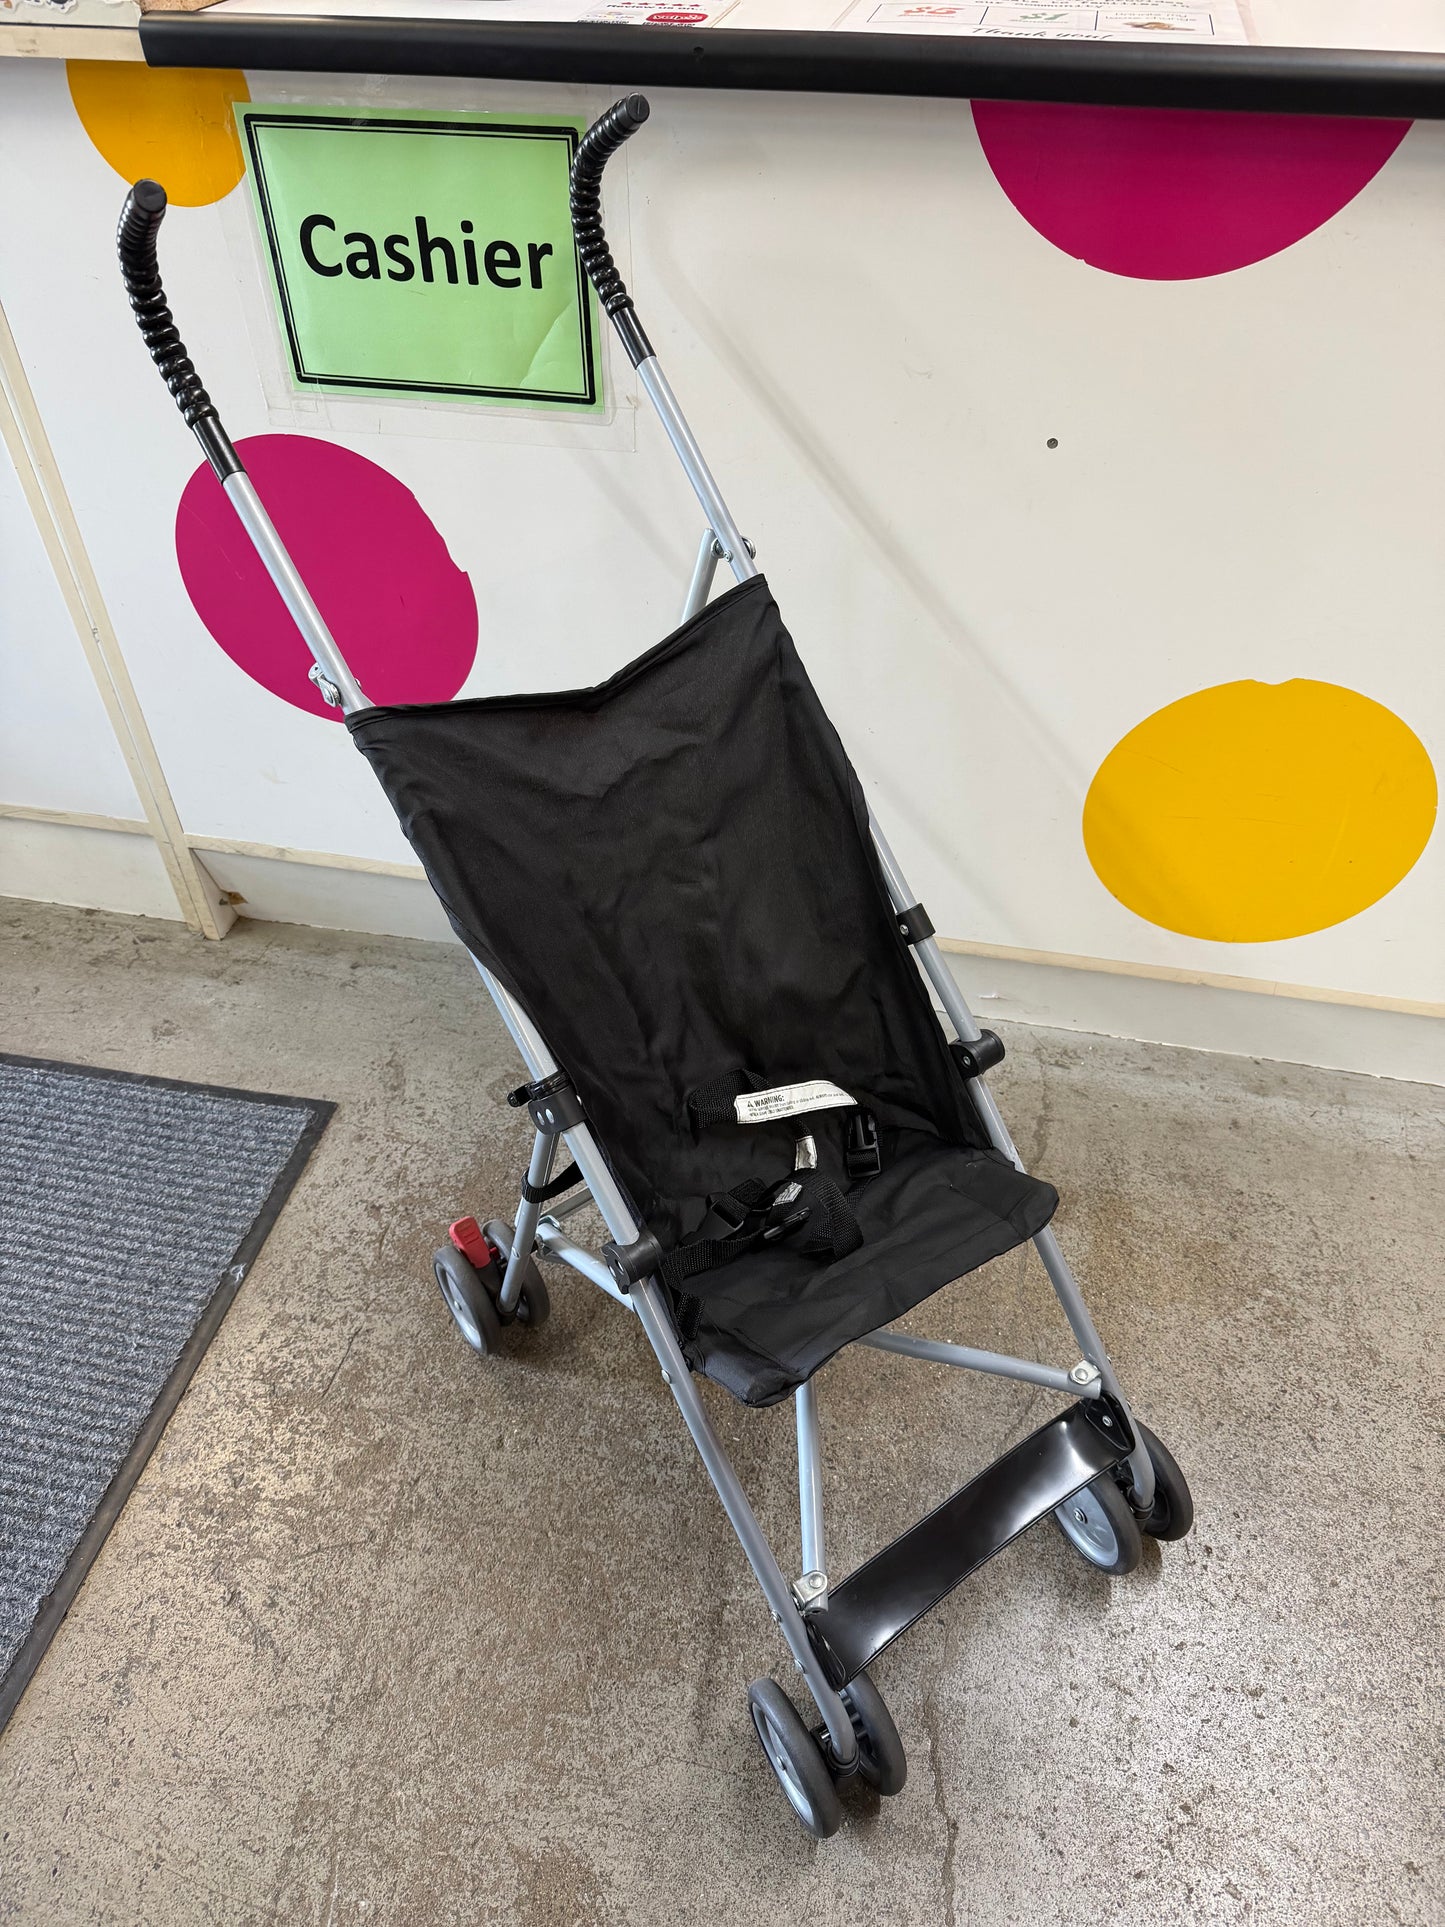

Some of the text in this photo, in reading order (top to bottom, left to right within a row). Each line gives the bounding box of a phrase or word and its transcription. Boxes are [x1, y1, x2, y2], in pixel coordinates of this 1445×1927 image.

[972, 27, 1114, 40] Thank you!
[299, 213, 553, 289] Cashier
[754, 1094, 785, 1108] WARNING:
